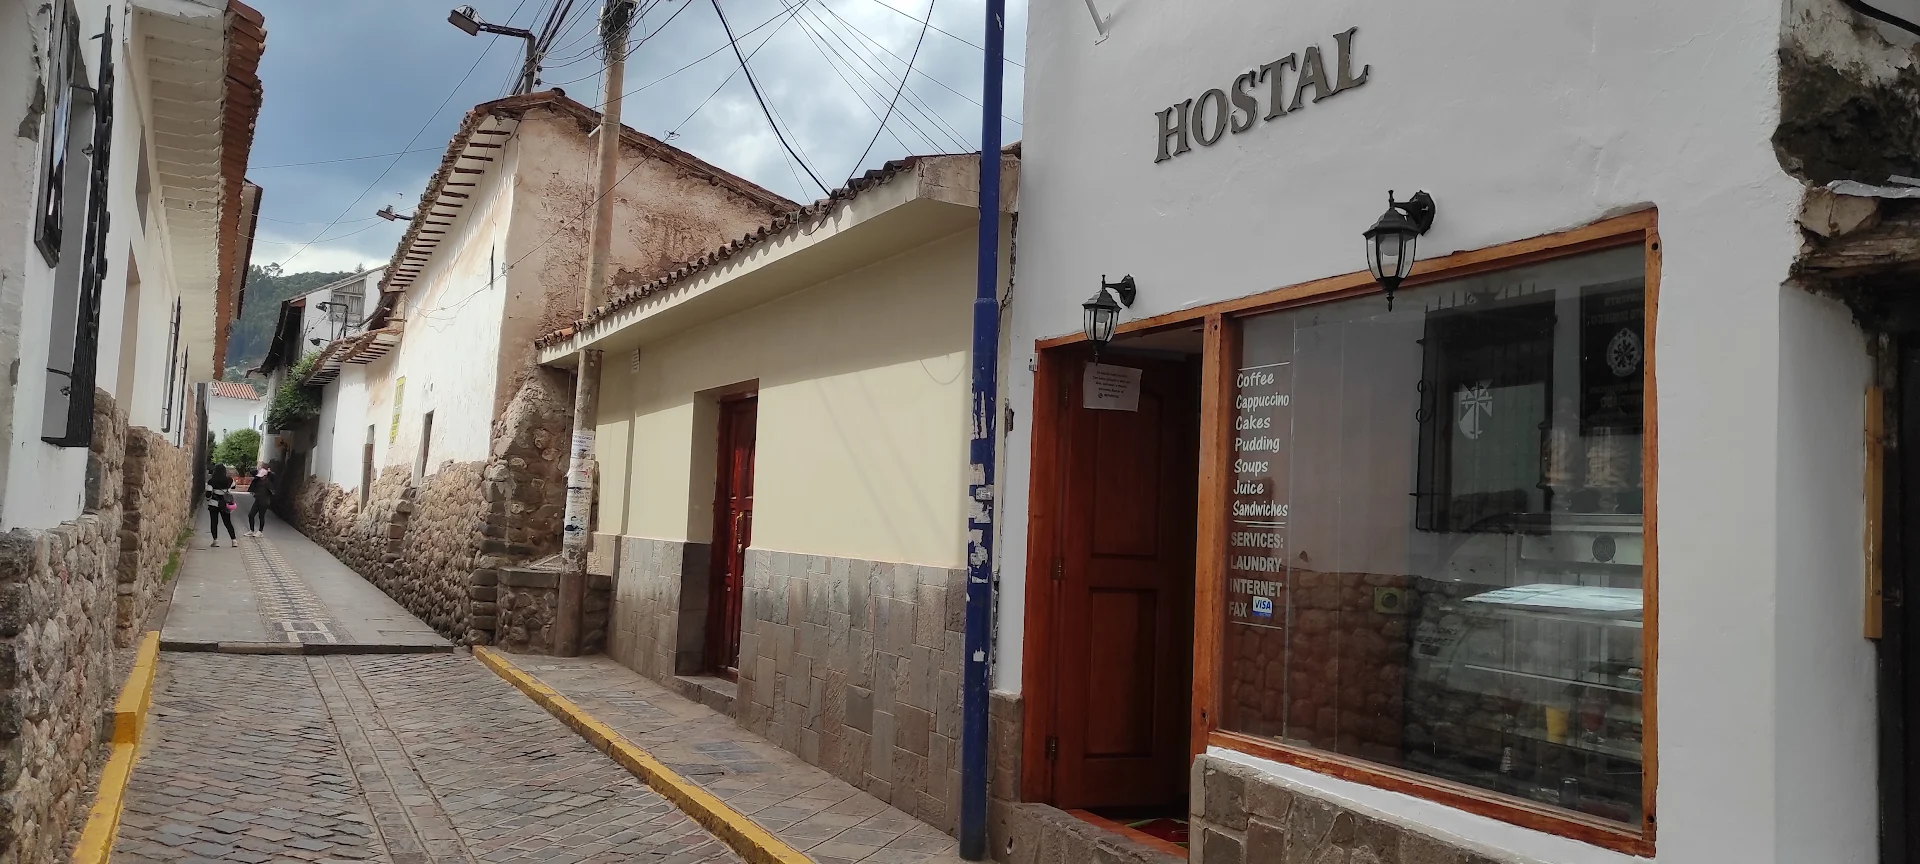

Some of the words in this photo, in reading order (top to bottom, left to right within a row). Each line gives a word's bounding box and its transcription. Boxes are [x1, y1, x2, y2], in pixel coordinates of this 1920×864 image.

[1154, 25, 1369, 164] HOSTAL
[1236, 371, 1275, 389] Coffee
[1236, 392, 1290, 412] Cappuccino
[1235, 415, 1271, 431] Cakes
[1234, 436, 1280, 453] Pudding
[1234, 459, 1269, 477] Soups
[1233, 479, 1264, 495] Juice
[1232, 500, 1289, 517] Sandwiches
[1231, 532, 1284, 549] SERVICES:
[1230, 555, 1282, 573] LAUNDRY
[1229, 578, 1283, 597] INTERNET
[1228, 602, 1248, 618] FAX
[1255, 599, 1272, 611] VISA
